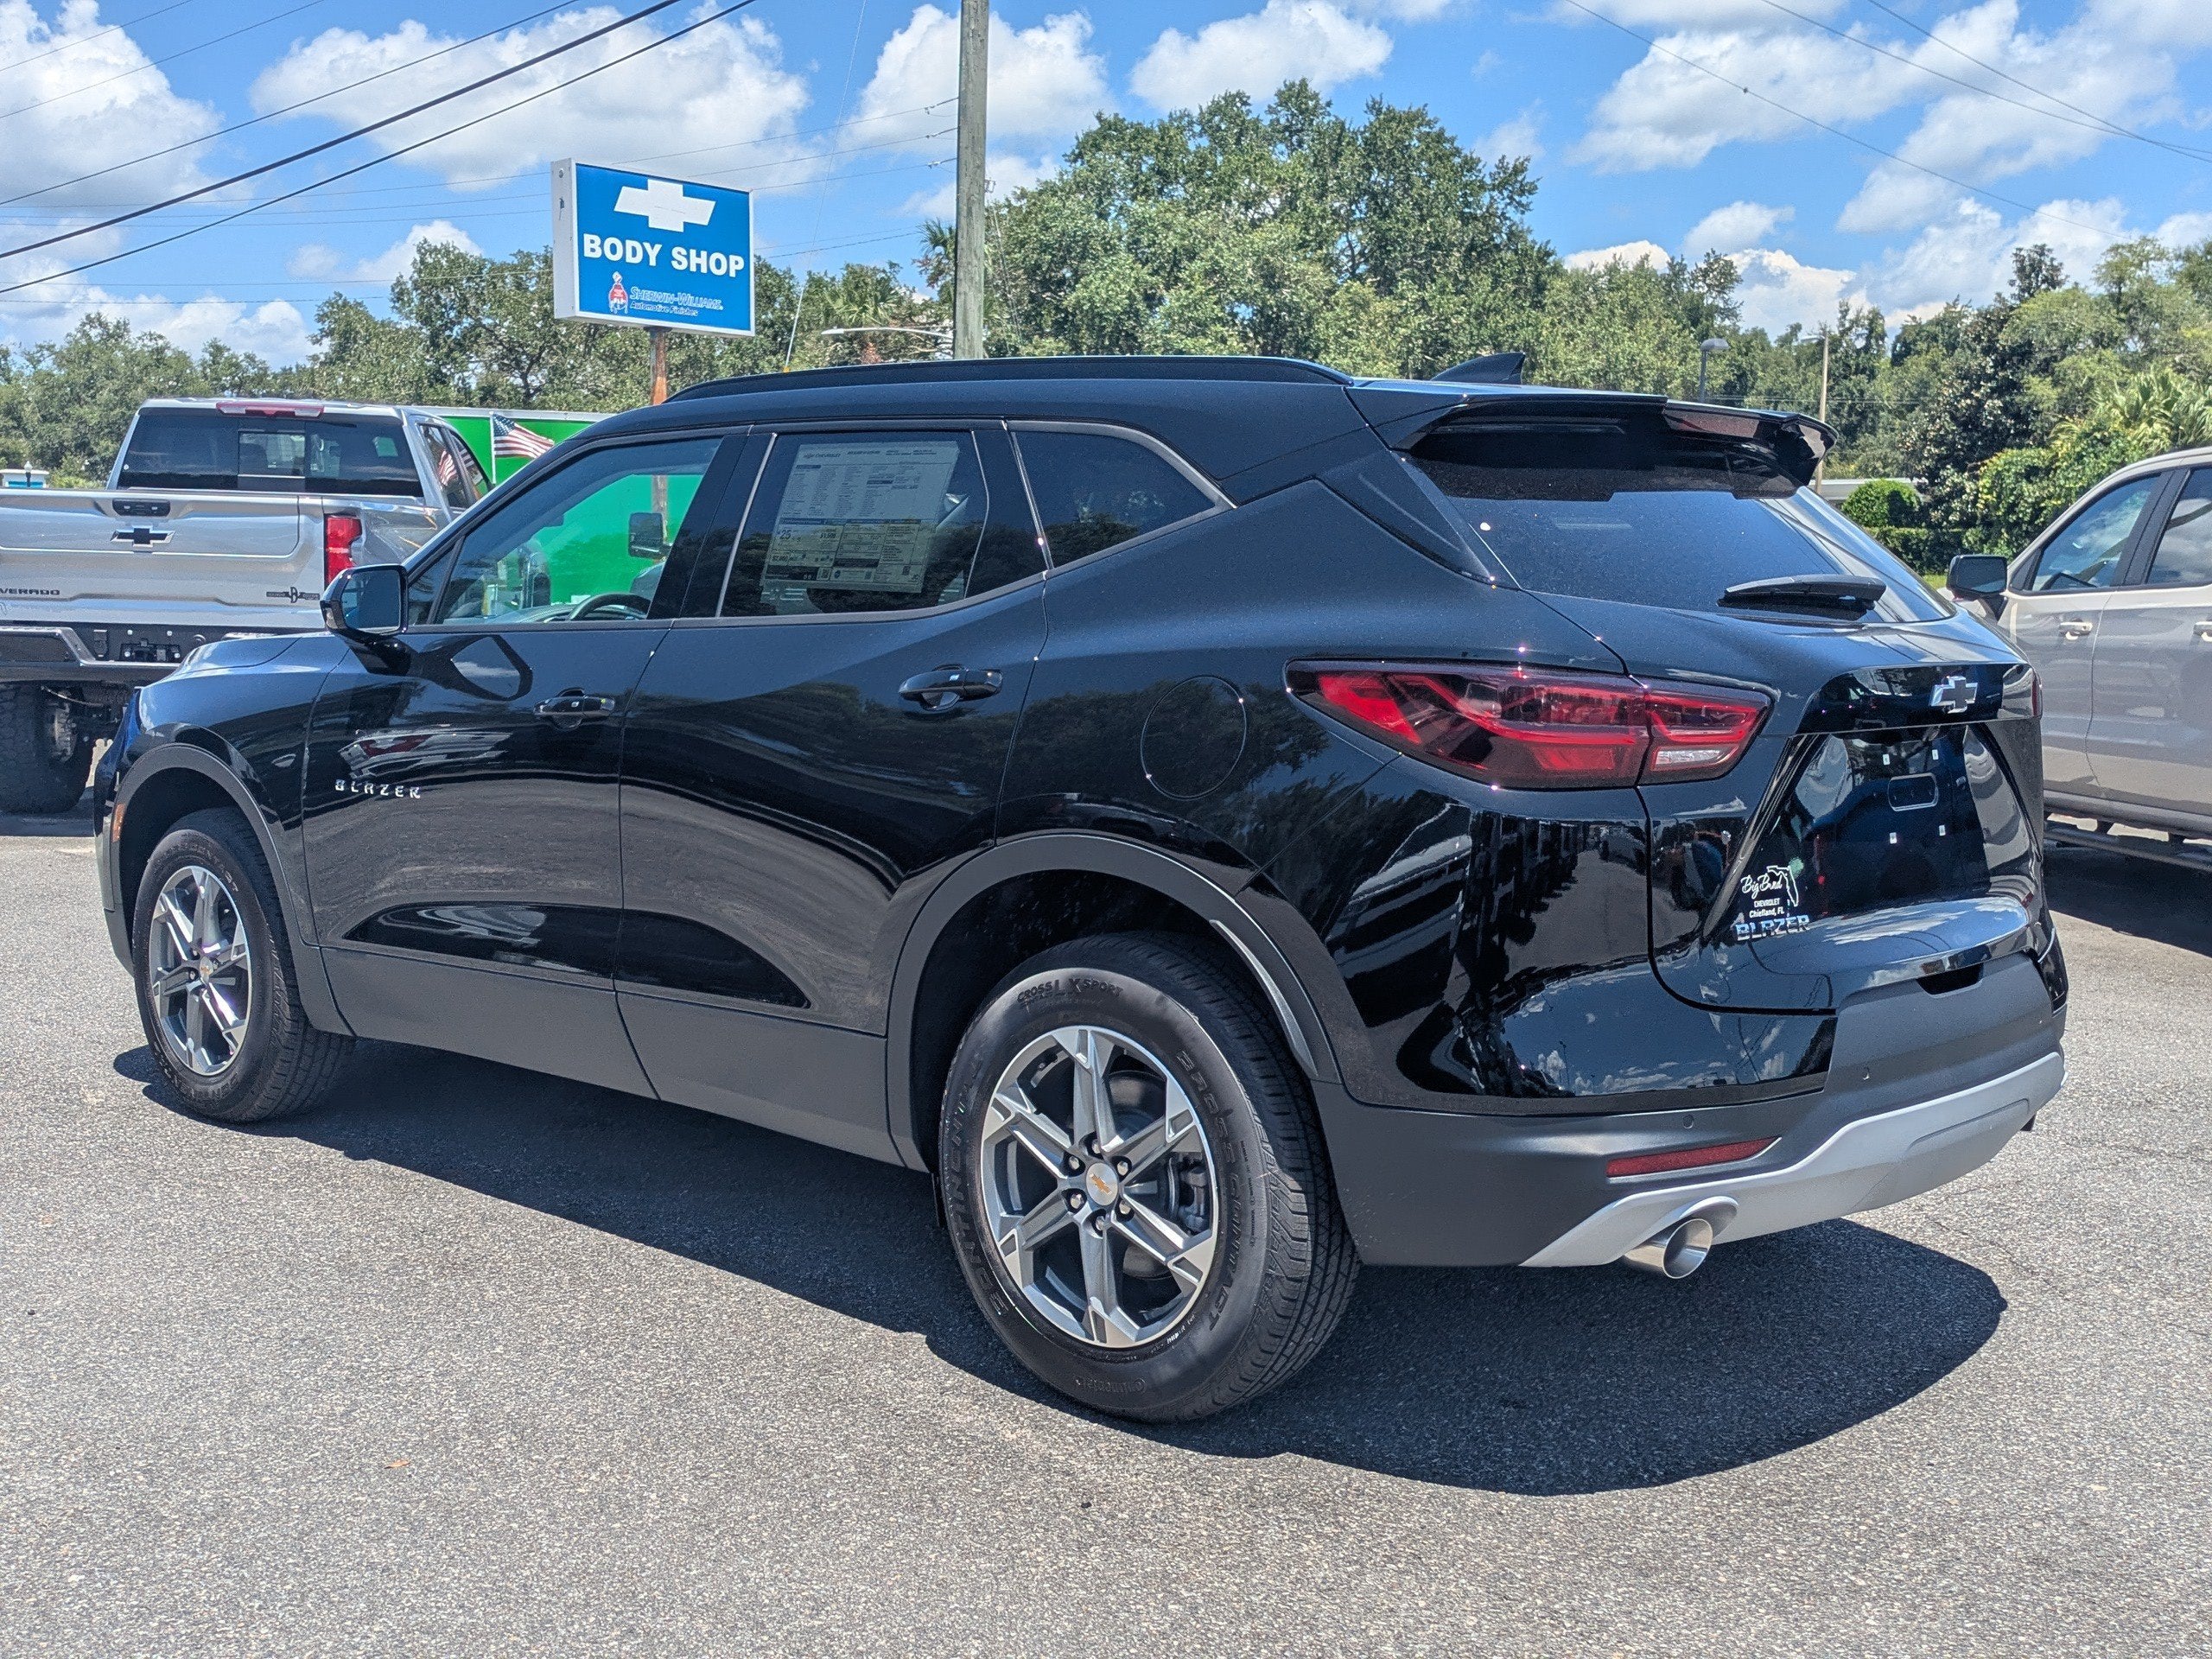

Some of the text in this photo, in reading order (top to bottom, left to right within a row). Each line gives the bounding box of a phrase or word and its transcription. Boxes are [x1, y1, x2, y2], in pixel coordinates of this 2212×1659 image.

[583, 233, 745, 278] BODY SHOP
[334, 779, 421, 799] BLAZER
[1740, 874, 1760, 899] Big
[1754, 898, 1781, 907] CHEVROLET
[1777, 906, 1785, 915] FL
[1735, 914, 1810, 941] BLAZER
